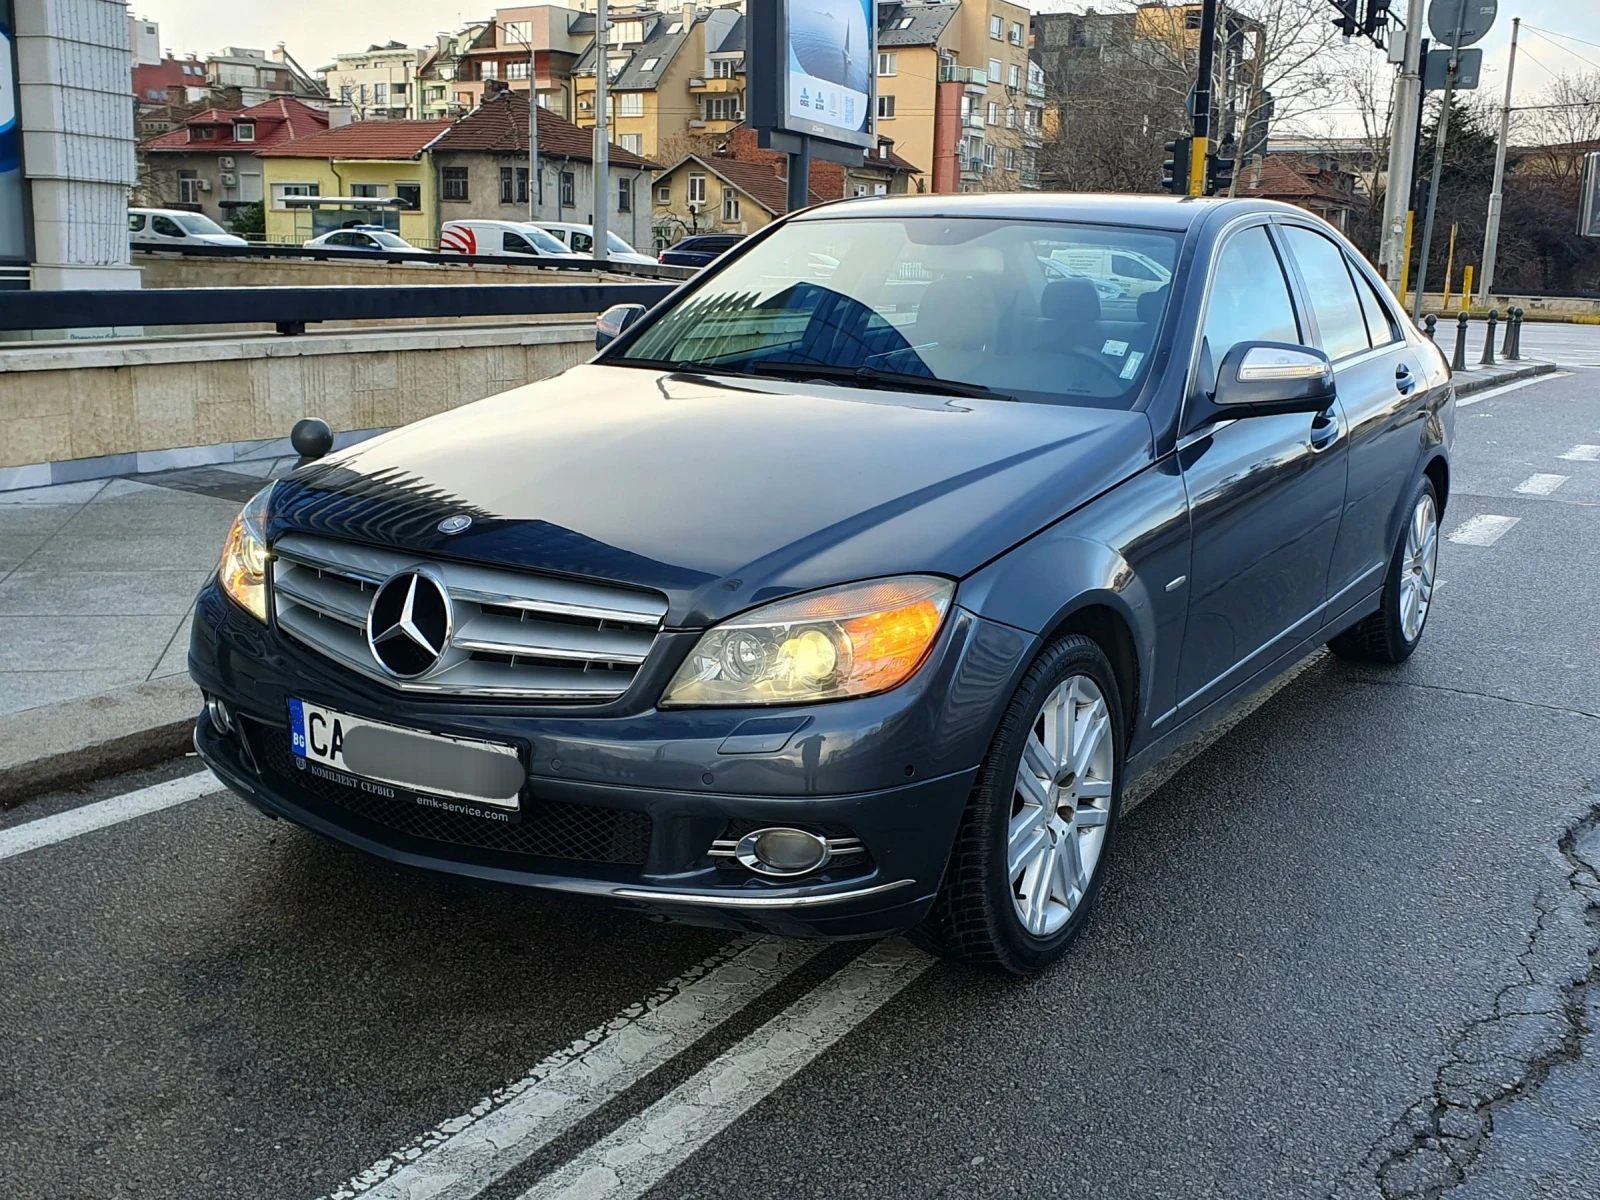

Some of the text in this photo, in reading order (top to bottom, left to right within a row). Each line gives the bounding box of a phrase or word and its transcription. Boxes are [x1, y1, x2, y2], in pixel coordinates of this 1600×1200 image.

[293, 731, 305, 748] BG
[311, 765, 395, 798] КОМПЛЕКТ СЕРВИЗ
[416, 795, 509, 822] emk-service.com
